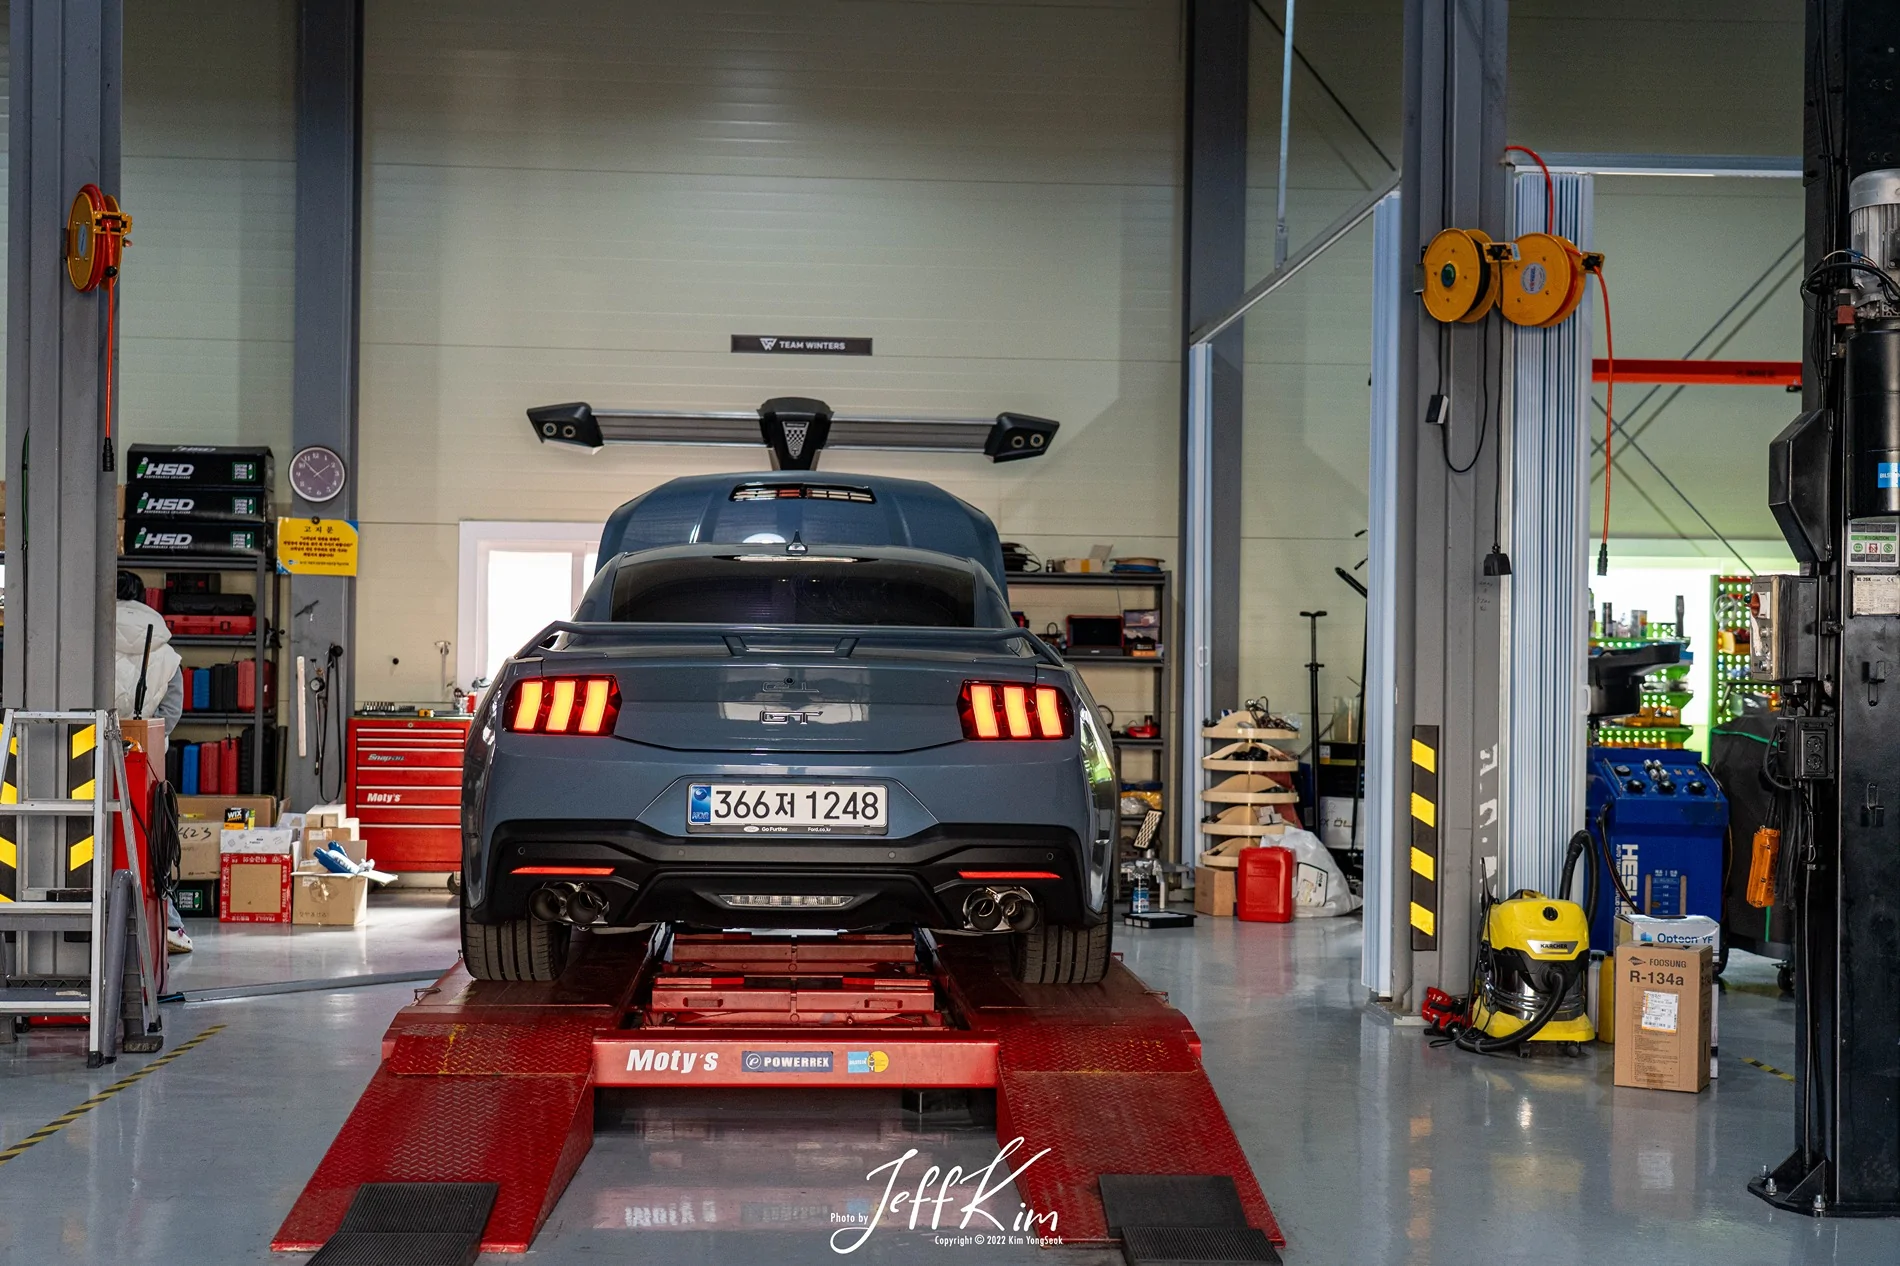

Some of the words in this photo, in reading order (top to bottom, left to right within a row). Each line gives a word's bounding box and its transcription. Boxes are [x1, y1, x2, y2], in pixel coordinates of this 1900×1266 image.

[779, 341, 804, 349] TEAM
[806, 341, 846, 350] WINTERS
[146, 463, 195, 476] HSD
[146, 498, 195, 511] HSD
[144, 533, 193, 546] HSD
[760, 710, 823, 725] GT
[367, 793, 402, 803] Moty's
[714, 790, 795, 819] 366저
[806, 790, 879, 820] 1248
[227, 810, 242, 819] WIX
[1702, 936, 1713, 944] YF
[1649, 959, 1687, 968] FOOSUNG
[1629, 970, 1684, 986] R-134a
[626, 1050, 719, 1074] Moty's
[764, 1056, 829, 1067] POWERREX
